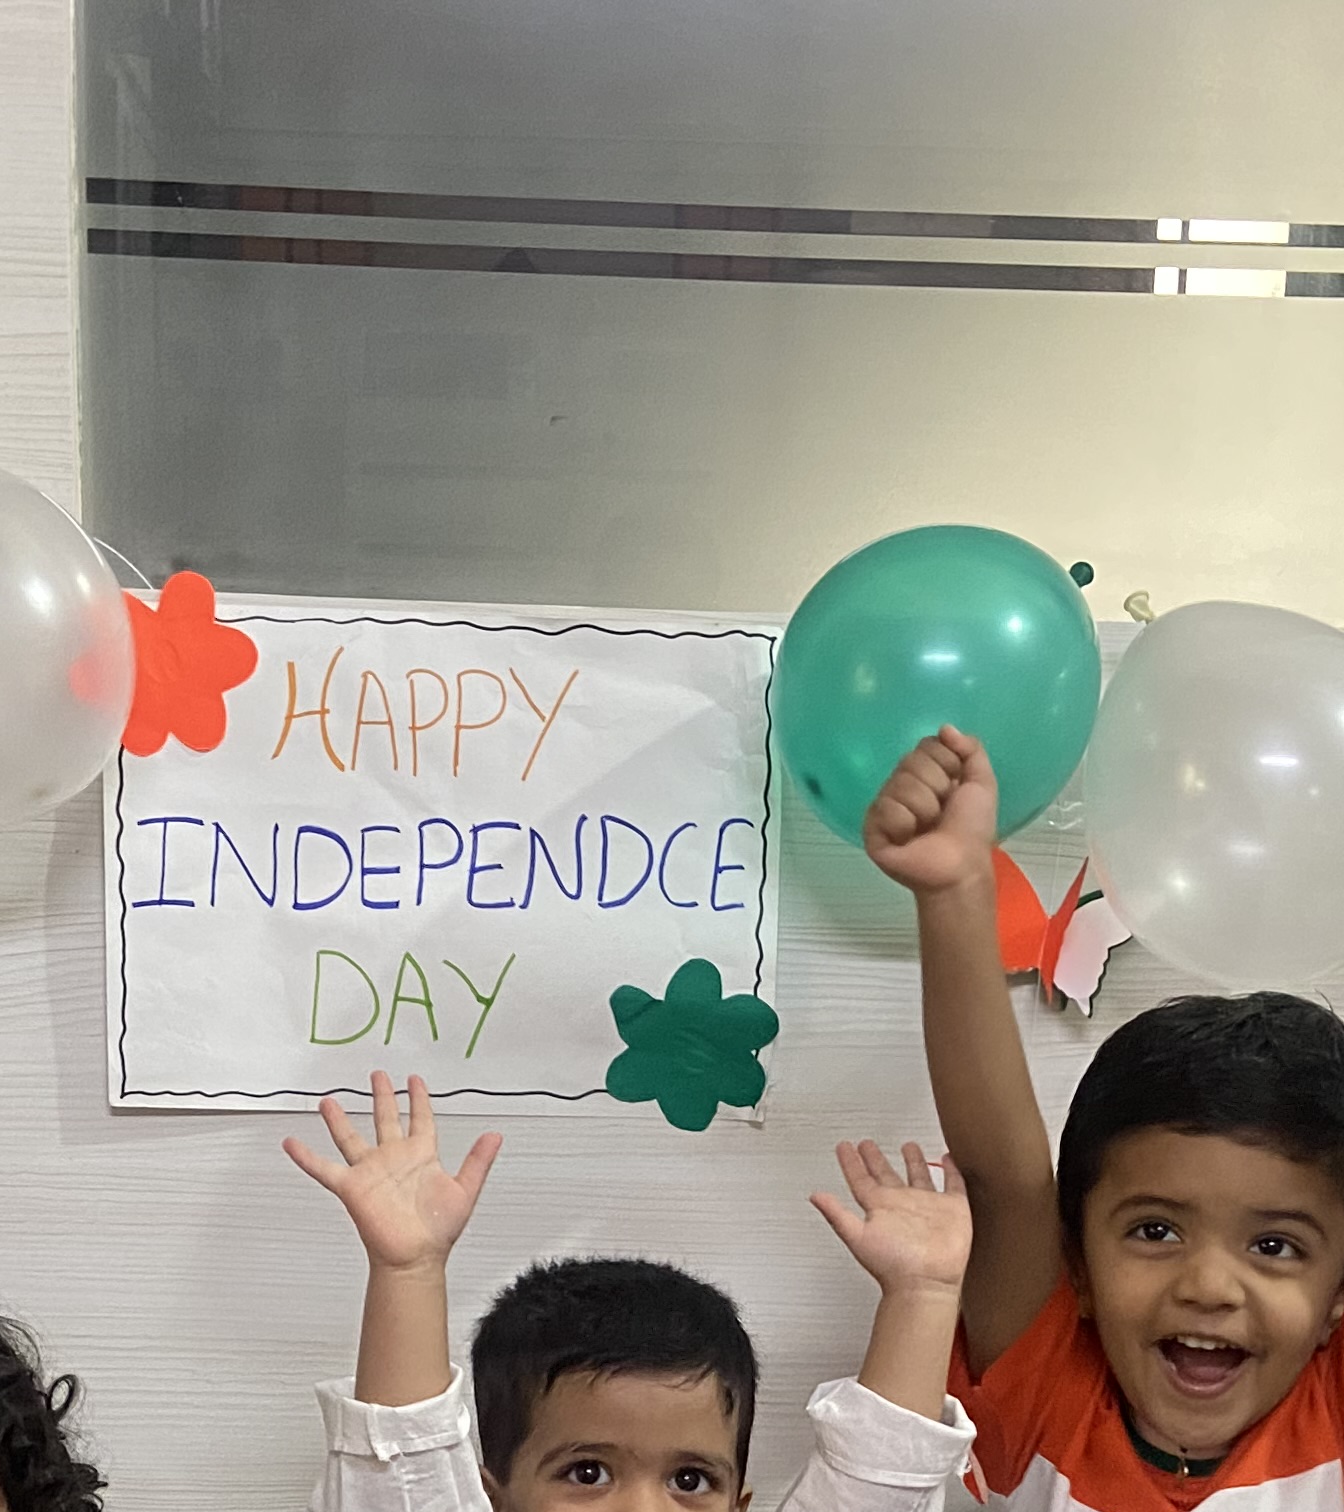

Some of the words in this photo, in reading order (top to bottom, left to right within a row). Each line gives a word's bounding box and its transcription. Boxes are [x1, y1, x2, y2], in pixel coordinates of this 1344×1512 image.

[271, 646, 579, 781] HAPPY
[132, 814, 755, 911] INDEPENDCE
[308, 949, 517, 1059] DAY
